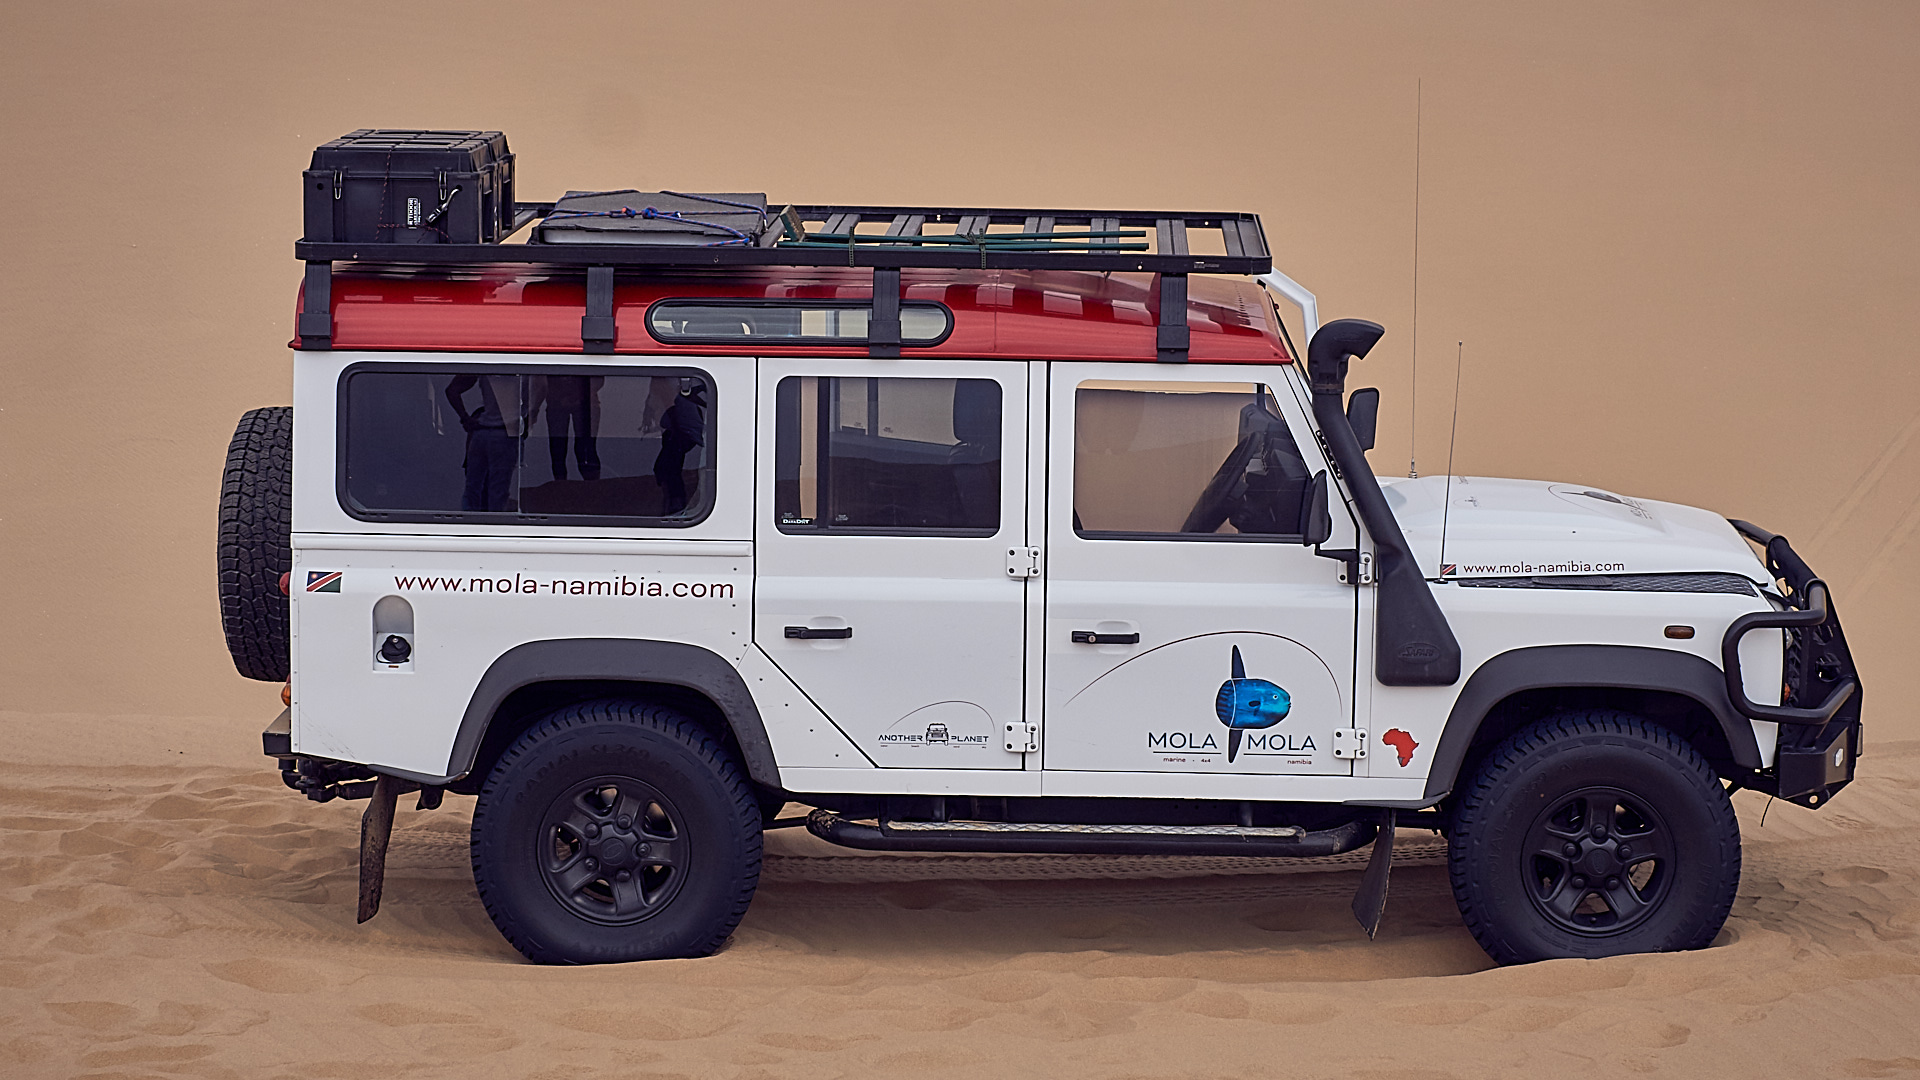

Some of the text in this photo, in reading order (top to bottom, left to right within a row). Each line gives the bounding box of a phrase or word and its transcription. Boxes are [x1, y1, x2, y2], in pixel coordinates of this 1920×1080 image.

[1463, 560, 1626, 574] www.mola-namibia.com
[393, 573, 735, 599] www.mola-namibia.com
[878, 734, 989, 743] ANOTHER PLANET
[1148, 731, 1317, 751] MOLA MOLA
